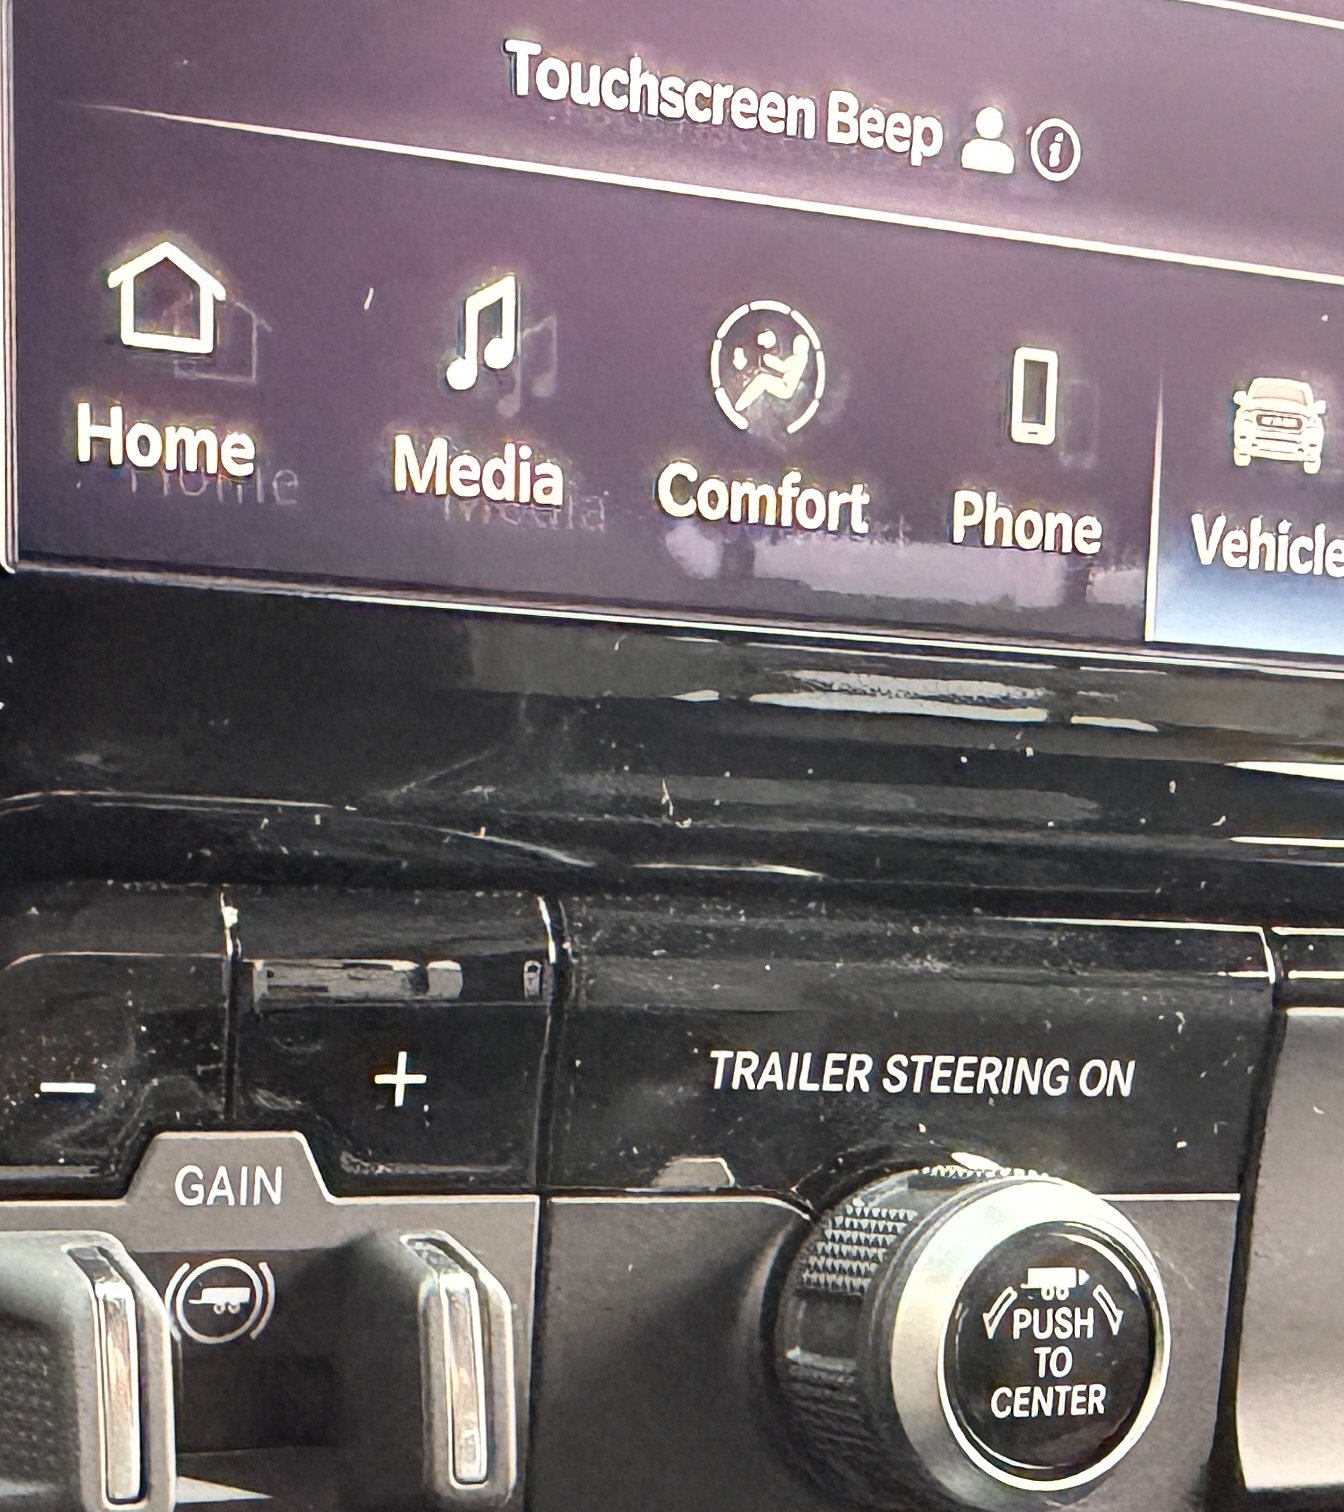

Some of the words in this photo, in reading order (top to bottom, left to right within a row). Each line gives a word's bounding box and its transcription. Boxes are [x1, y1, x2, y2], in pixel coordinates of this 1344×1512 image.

[503, 37, 816, 140] Touchscreen
[826, 90, 944, 166] Beep
[75, 401, 257, 478] Home
[392, 434, 564, 508] Media
[656, 459, 869, 534] Comfort
[952, 489, 1104, 556] Phone
[709, 1049, 873, 1093] TRAILER
[881, 1052, 1070, 1096] STEERING
[1077, 1058, 1136, 1098] ON
[172, 1163, 285, 1207] GAIN
[1012, 1307, 1095, 1341] PUSH
[1033, 1346, 1073, 1379] TO
[990, 1383, 1107, 1418] CENTER
